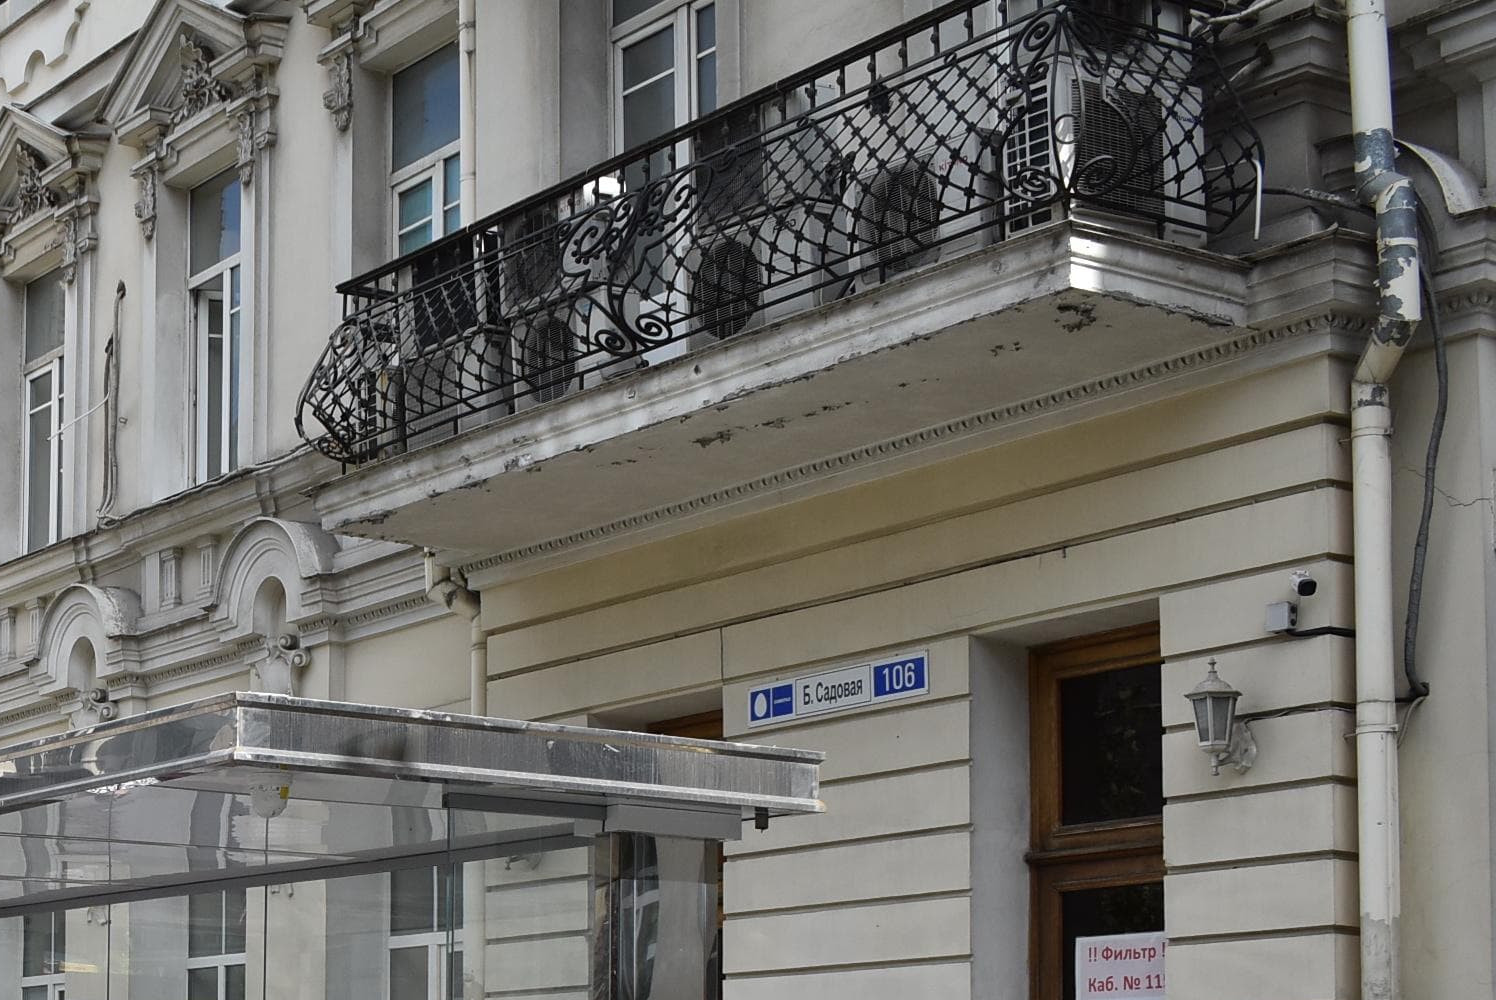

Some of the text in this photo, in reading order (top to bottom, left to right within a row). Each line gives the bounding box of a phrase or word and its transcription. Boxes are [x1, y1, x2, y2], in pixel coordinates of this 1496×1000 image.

[803, 662, 915, 705] Б. Садовая 106
[1101, 946, 1156, 962] Фильтр
[1088, 974, 1165, 992] Каб. № 11
